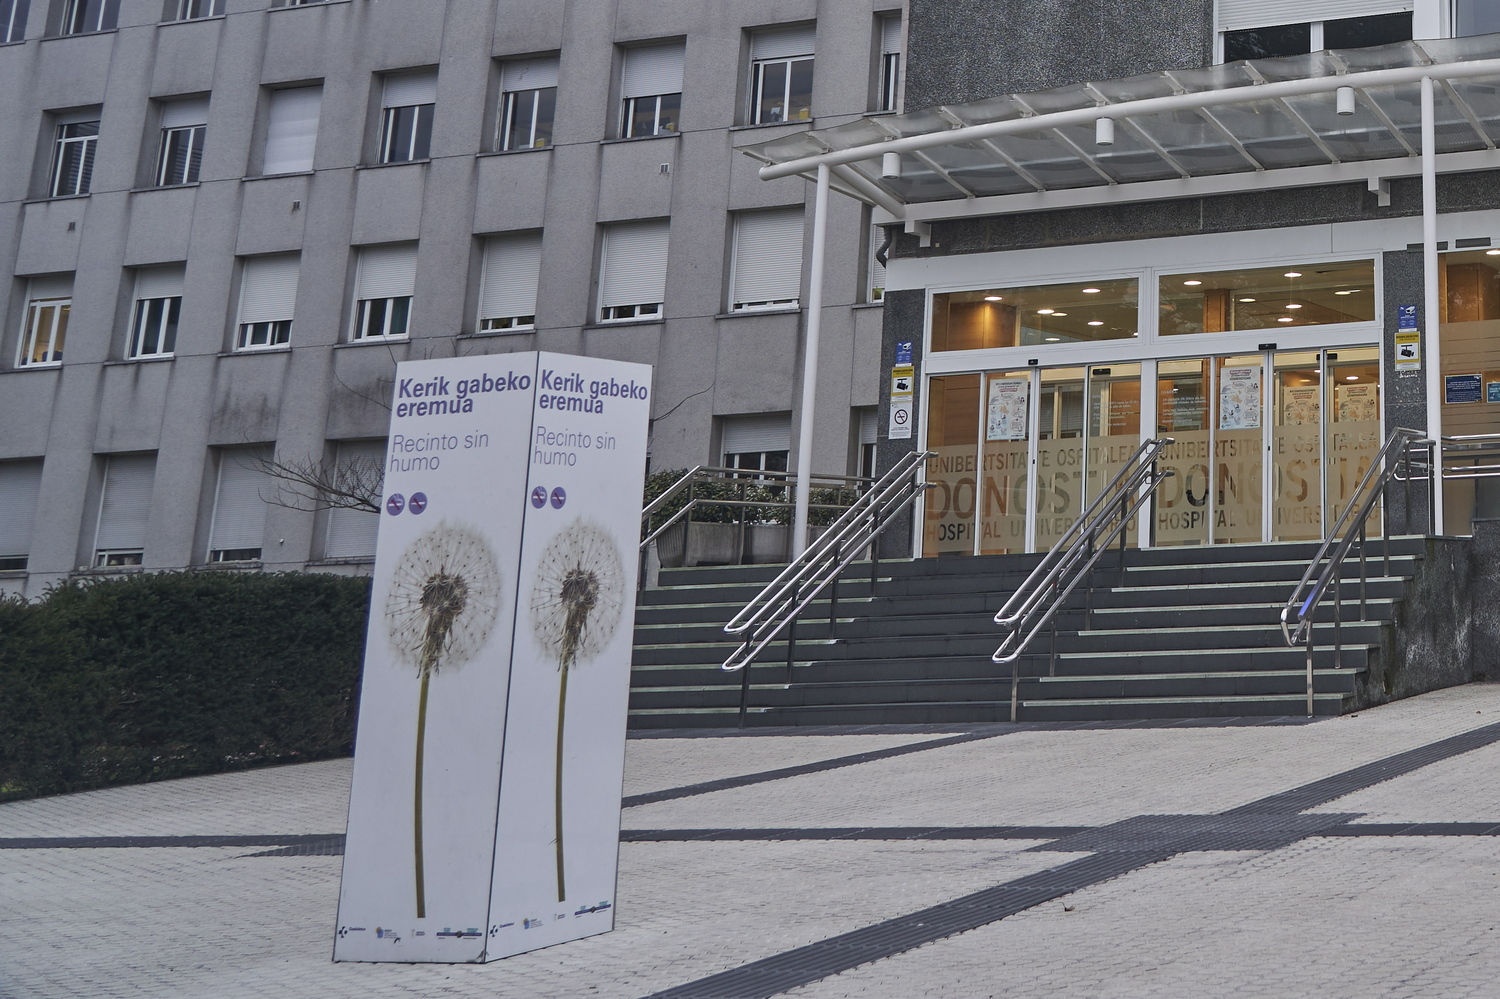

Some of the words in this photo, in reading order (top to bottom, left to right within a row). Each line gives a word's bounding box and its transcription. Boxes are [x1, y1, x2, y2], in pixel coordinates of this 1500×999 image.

[398, 376, 449, 398] Kerik
[456, 371, 531, 399] gabeko
[540, 369, 584, 394] Kerik
[589, 378, 648, 400] gabeko
[396, 397, 474, 418] eremua
[539, 394, 604, 414] eremua
[392, 431, 458, 453] Recinto
[464, 430, 489, 448] sin
[536, 426, 591, 449] Recinto
[596, 431, 616, 449] sin
[390, 454, 440, 472] humo
[533, 446, 577, 466] humo
[1158, 510, 1236, 530] HOSPIAL
[926, 521, 1001, 541] HOSPIAL
